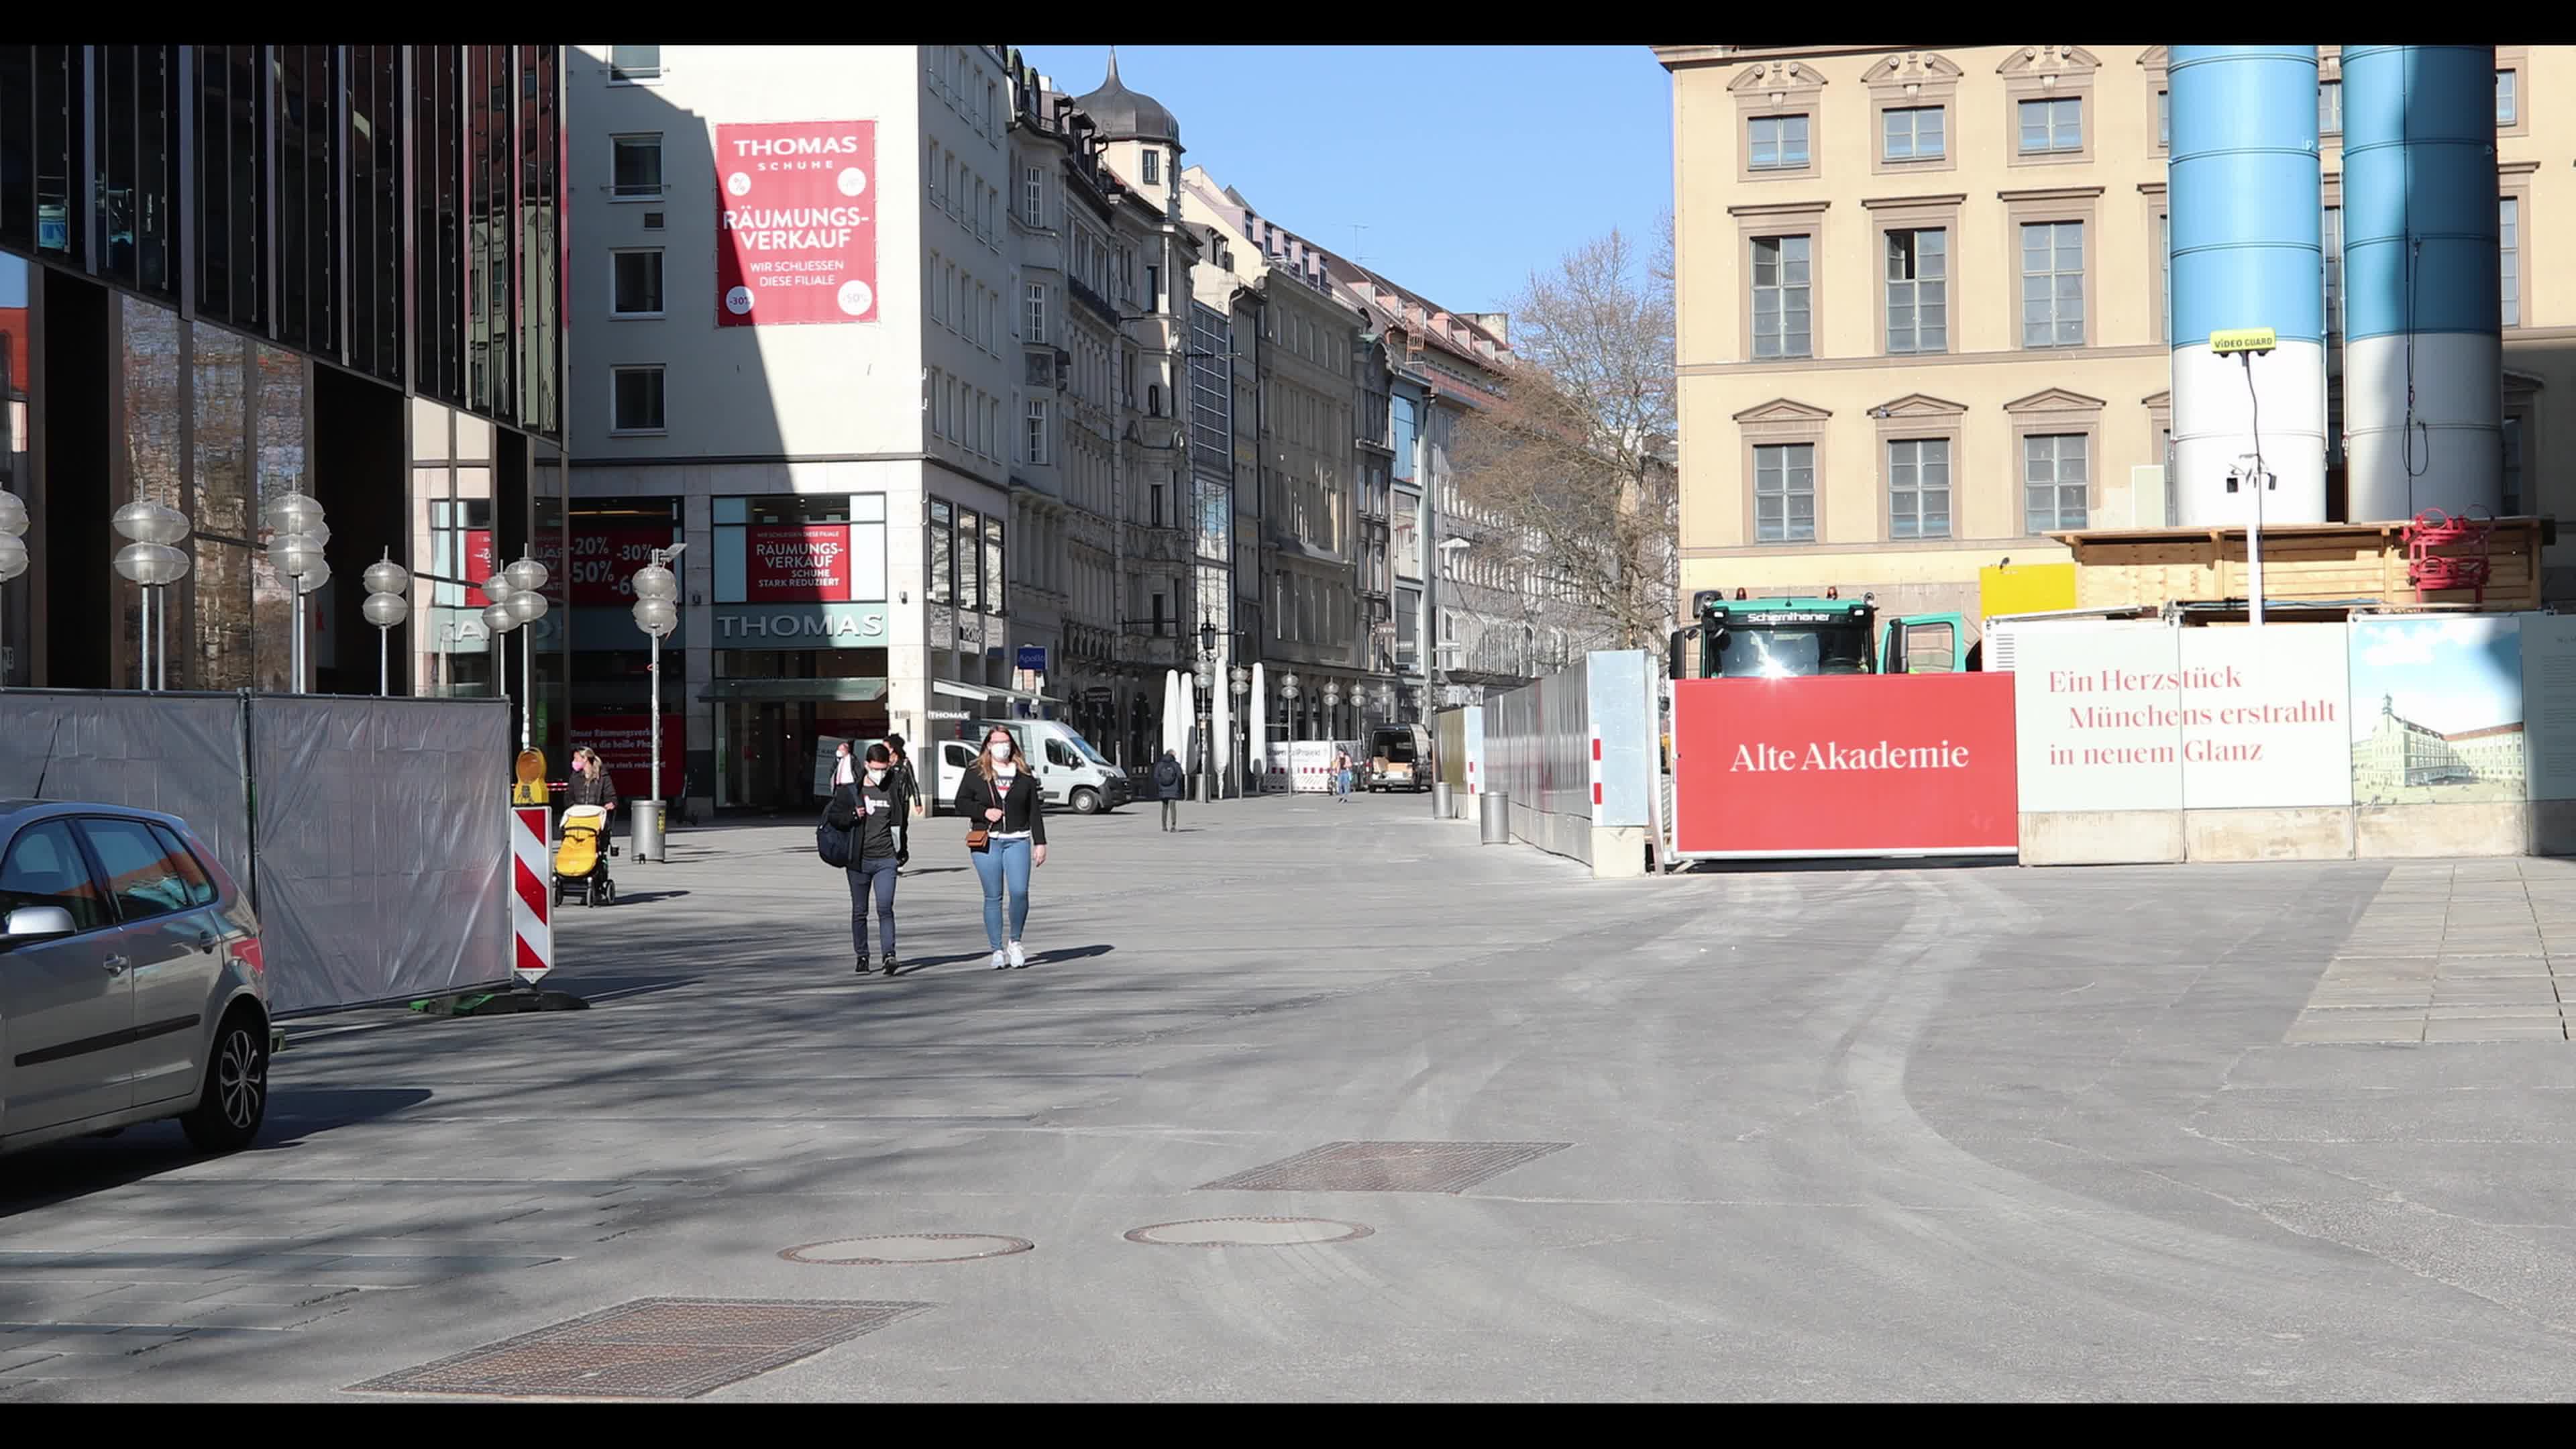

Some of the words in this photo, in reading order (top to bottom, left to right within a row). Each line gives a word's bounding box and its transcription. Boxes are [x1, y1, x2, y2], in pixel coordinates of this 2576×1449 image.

[733, 136, 857, 156] THOMAS
[757, 160, 833, 172] SCHUHE
[724, 205, 869, 229] RÄUMUNGS-
[741, 229, 851, 250] VERKAUF
[750, 262, 772, 272] WIR
[774, 260, 844, 272] SCHLIESSEN
[759, 276, 792, 286] DIESE
[795, 274, 835, 286] FILIALE
[2245, 337, 2273, 346] GUARD
[569, 537, 608, 555] -20%
[757, 541, 843, 555] RÄUMUNGS-
[765, 555, 833, 568] VERKAUF
[792, 570, 830, 578] SCHUHE
[759, 579, 787, 587] STARK
[789, 578, 840, 586] REDUZIERT
[716, 614, 883, 637] THOMAS
[1747, 612, 1830, 623] Schernthaner
[2049, 670, 2092, 693] Ein
[2102, 665, 2243, 692] Herzstück
[2069, 704, 2212, 729] Münchens
[2220, 700, 2337, 724] erstrahlt
[1729, 741, 1796, 772] Alte
[1801, 739, 1969, 771] Akademie
[2049, 743, 2074, 765] in
[2084, 745, 2175, 765] neuem
[2184, 739, 2263, 763] Glanz
